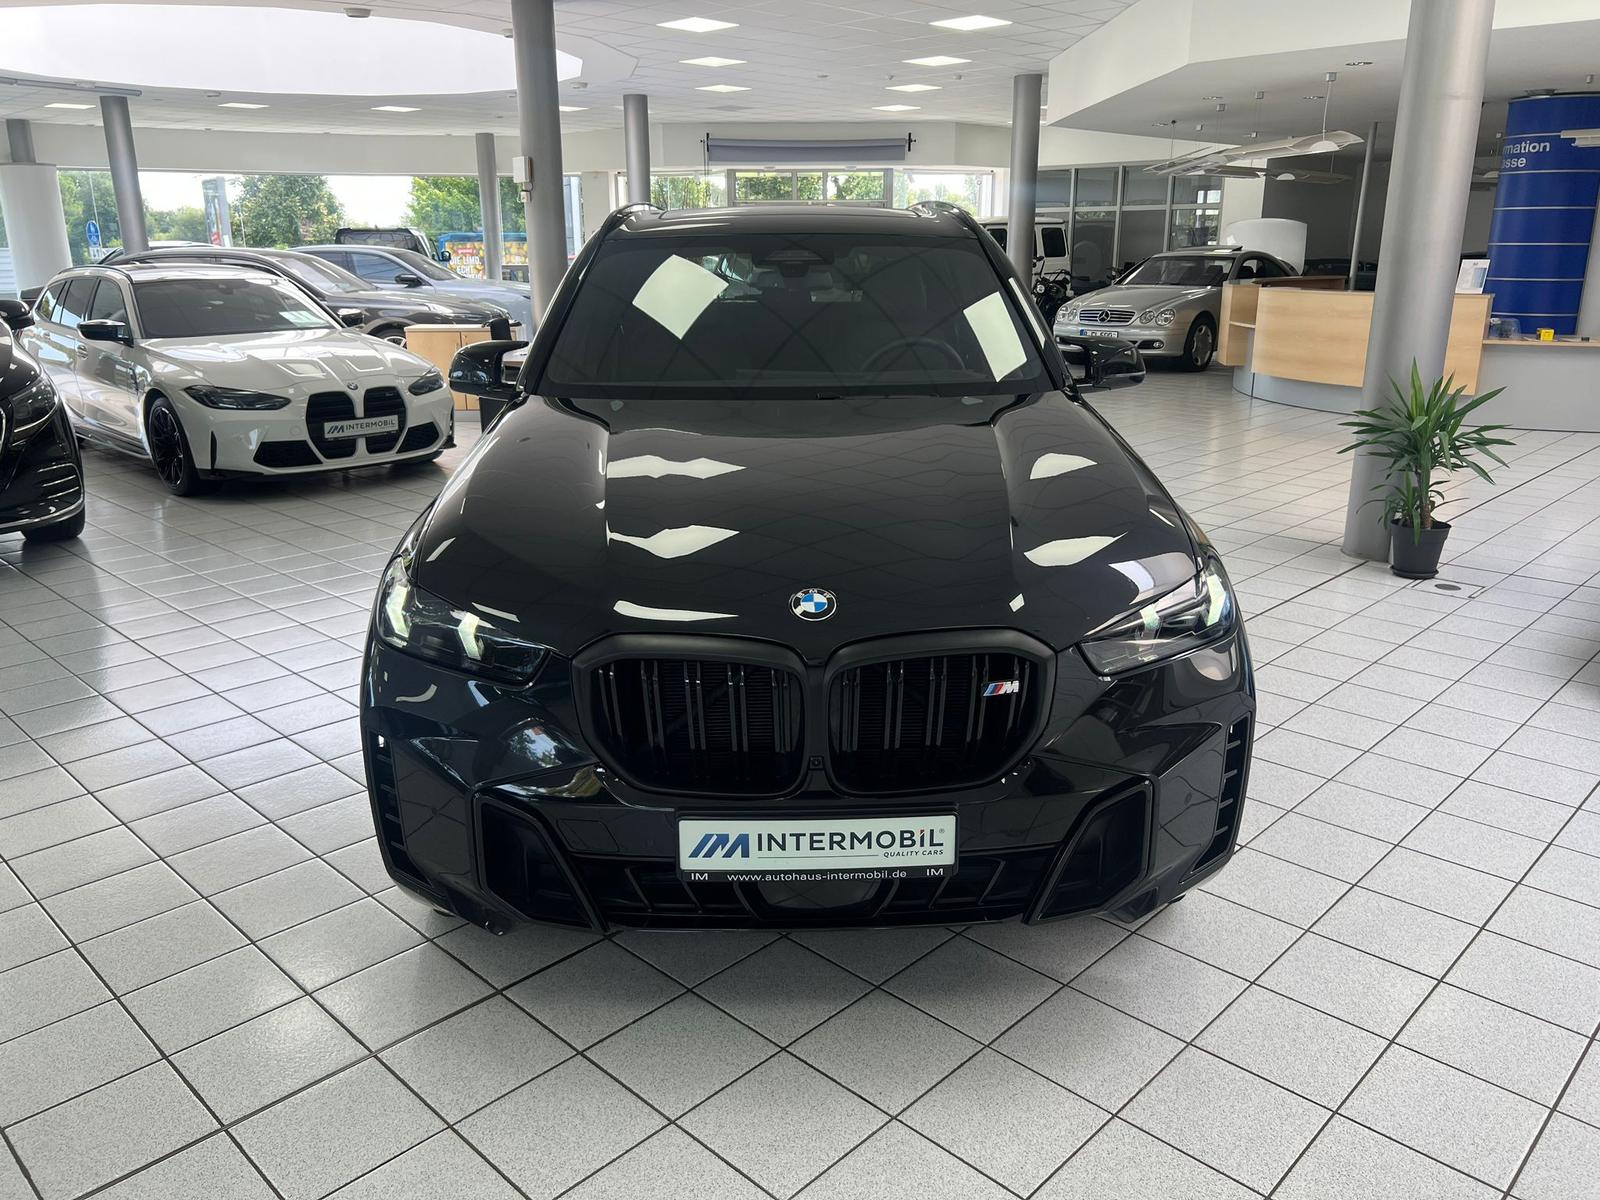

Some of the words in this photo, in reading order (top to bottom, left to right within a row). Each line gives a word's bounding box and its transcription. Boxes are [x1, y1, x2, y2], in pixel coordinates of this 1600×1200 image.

[883, 850, 919, 858] QUALITY
[691, 872, 709, 881] IM
[727, 869, 907, 882] www.autohaus-intermobil.de
[926, 868, 944, 876] IM
